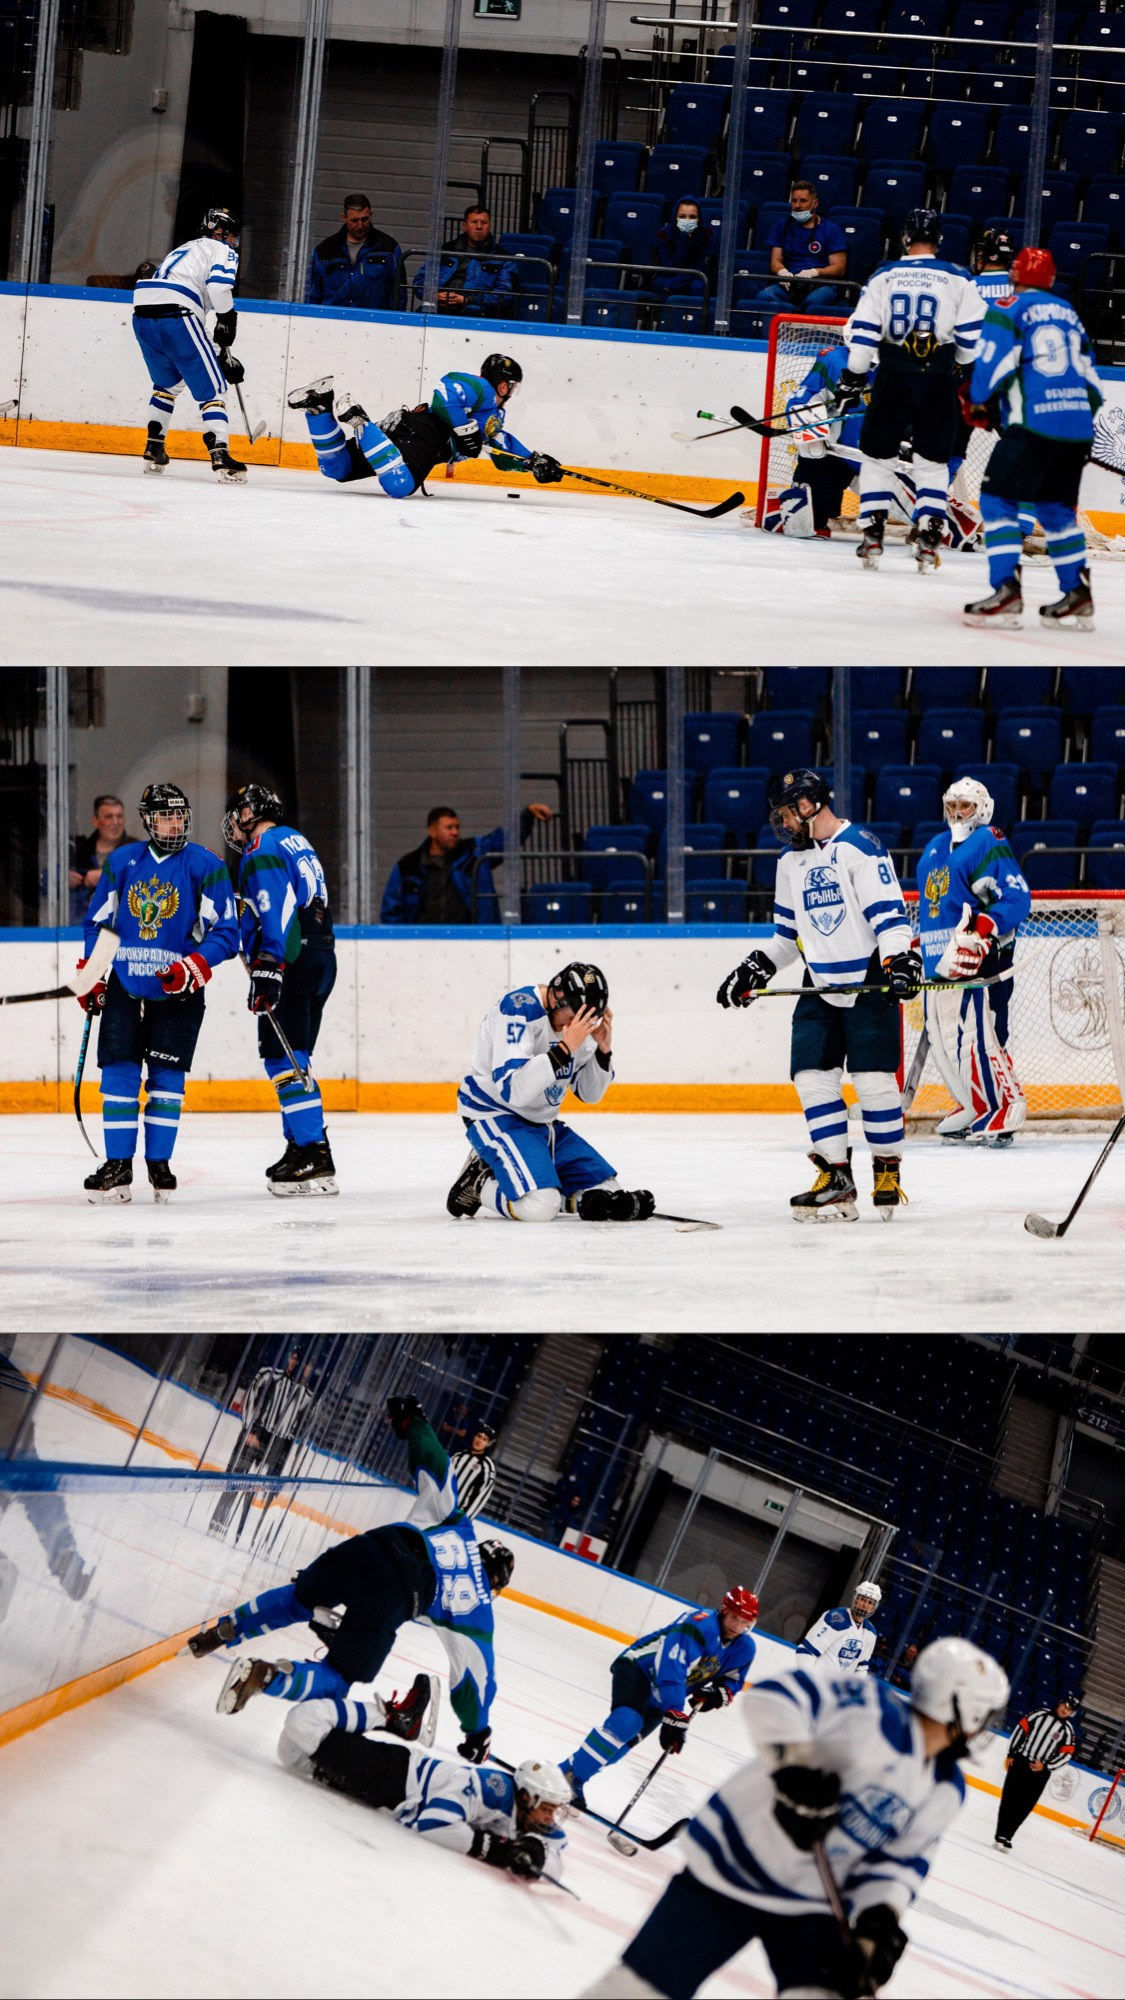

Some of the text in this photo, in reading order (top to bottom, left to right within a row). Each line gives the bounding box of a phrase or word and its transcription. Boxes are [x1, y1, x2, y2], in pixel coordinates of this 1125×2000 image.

[897, 279, 933, 289] РОССИИ
[889, 291, 941, 341] 88
[507, 1021, 526, 1044] 57
[150, 1050, 180, 1063] CCM
[990, 1056, 1015, 1100] CCM
[1087, 1414, 1109, 1430] 212
